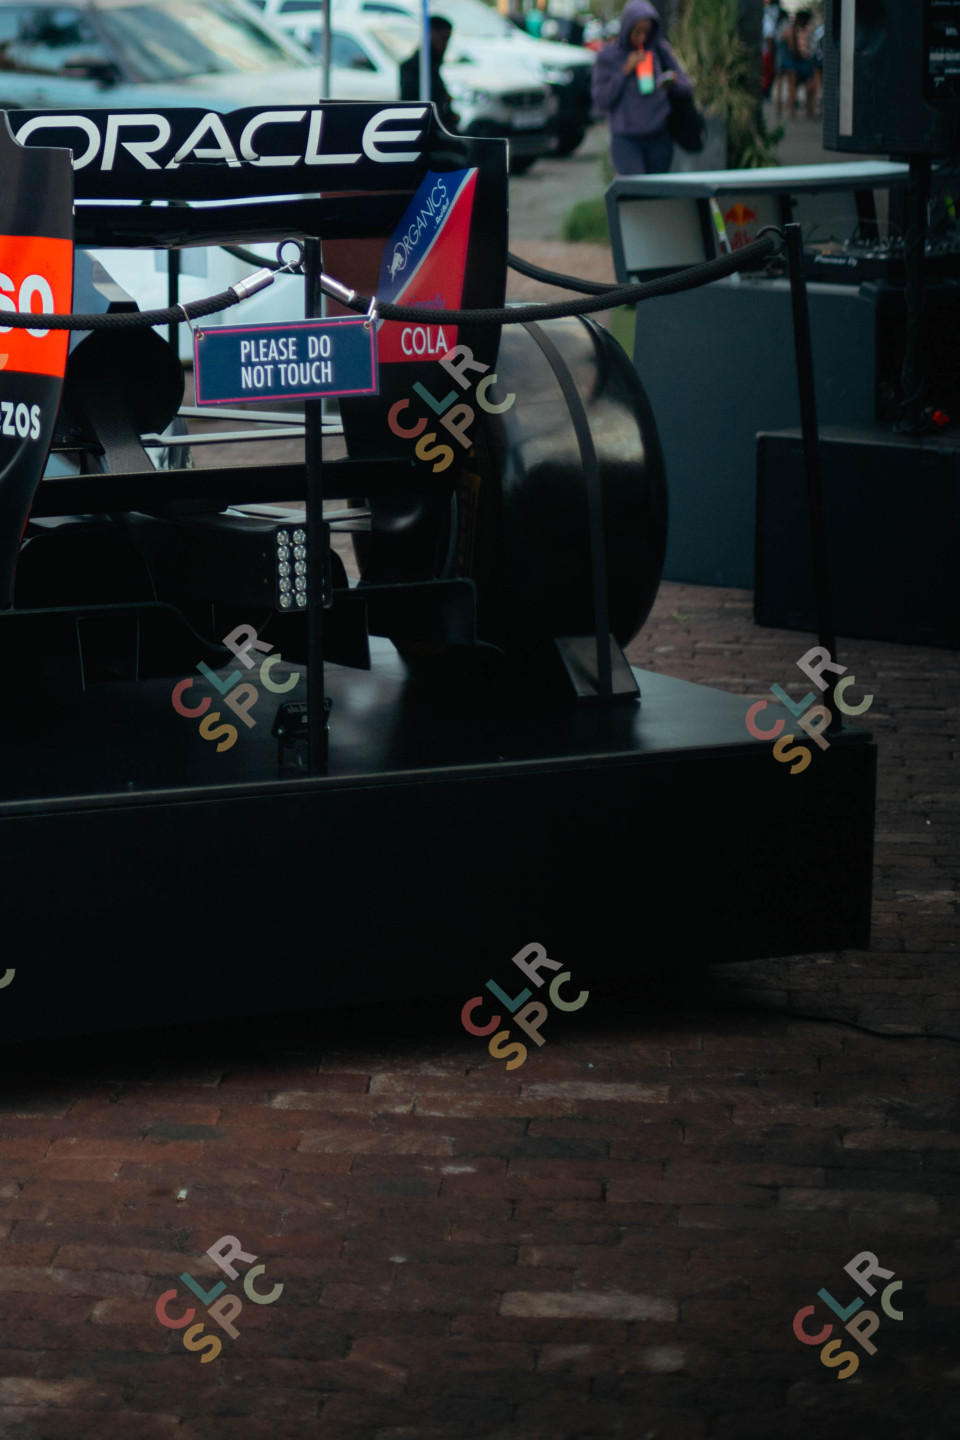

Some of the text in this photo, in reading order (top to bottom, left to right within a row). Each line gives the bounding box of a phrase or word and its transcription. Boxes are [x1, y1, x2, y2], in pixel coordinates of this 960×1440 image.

[15, 108, 427, 171] ORACLE
[393, 178, 448, 271] ORGANICS
[240, 335, 331, 363] PLEASE DO
[401, 325, 449, 356] COLA
[241, 361, 332, 388] NOT TOUCH
